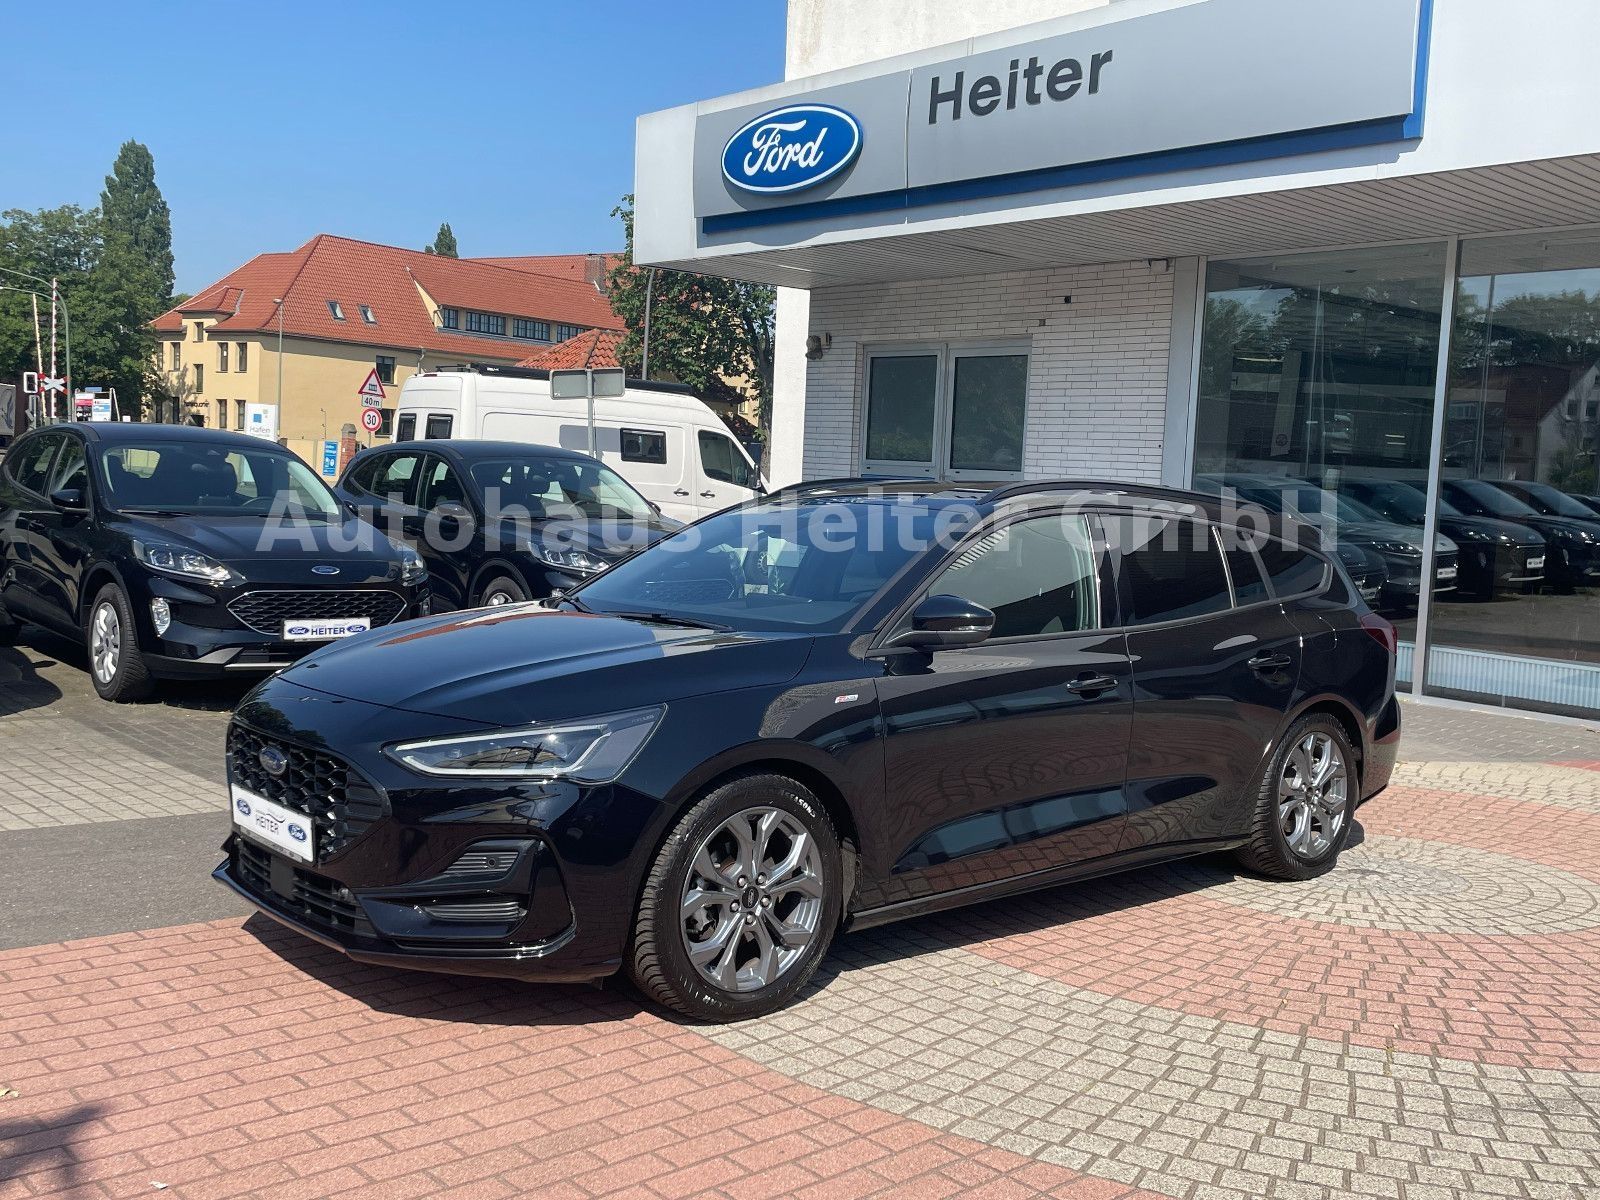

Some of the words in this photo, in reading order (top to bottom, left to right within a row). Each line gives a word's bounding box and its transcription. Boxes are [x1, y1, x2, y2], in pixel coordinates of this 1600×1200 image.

[928, 49, 1114, 126] Heiter
[743, 119, 828, 177] Ford
[364, 398, 373, 406] 40
[366, 414, 377, 426] 30
[249, 426, 271, 434] Hafen
[311, 627, 346, 636] HEITER
